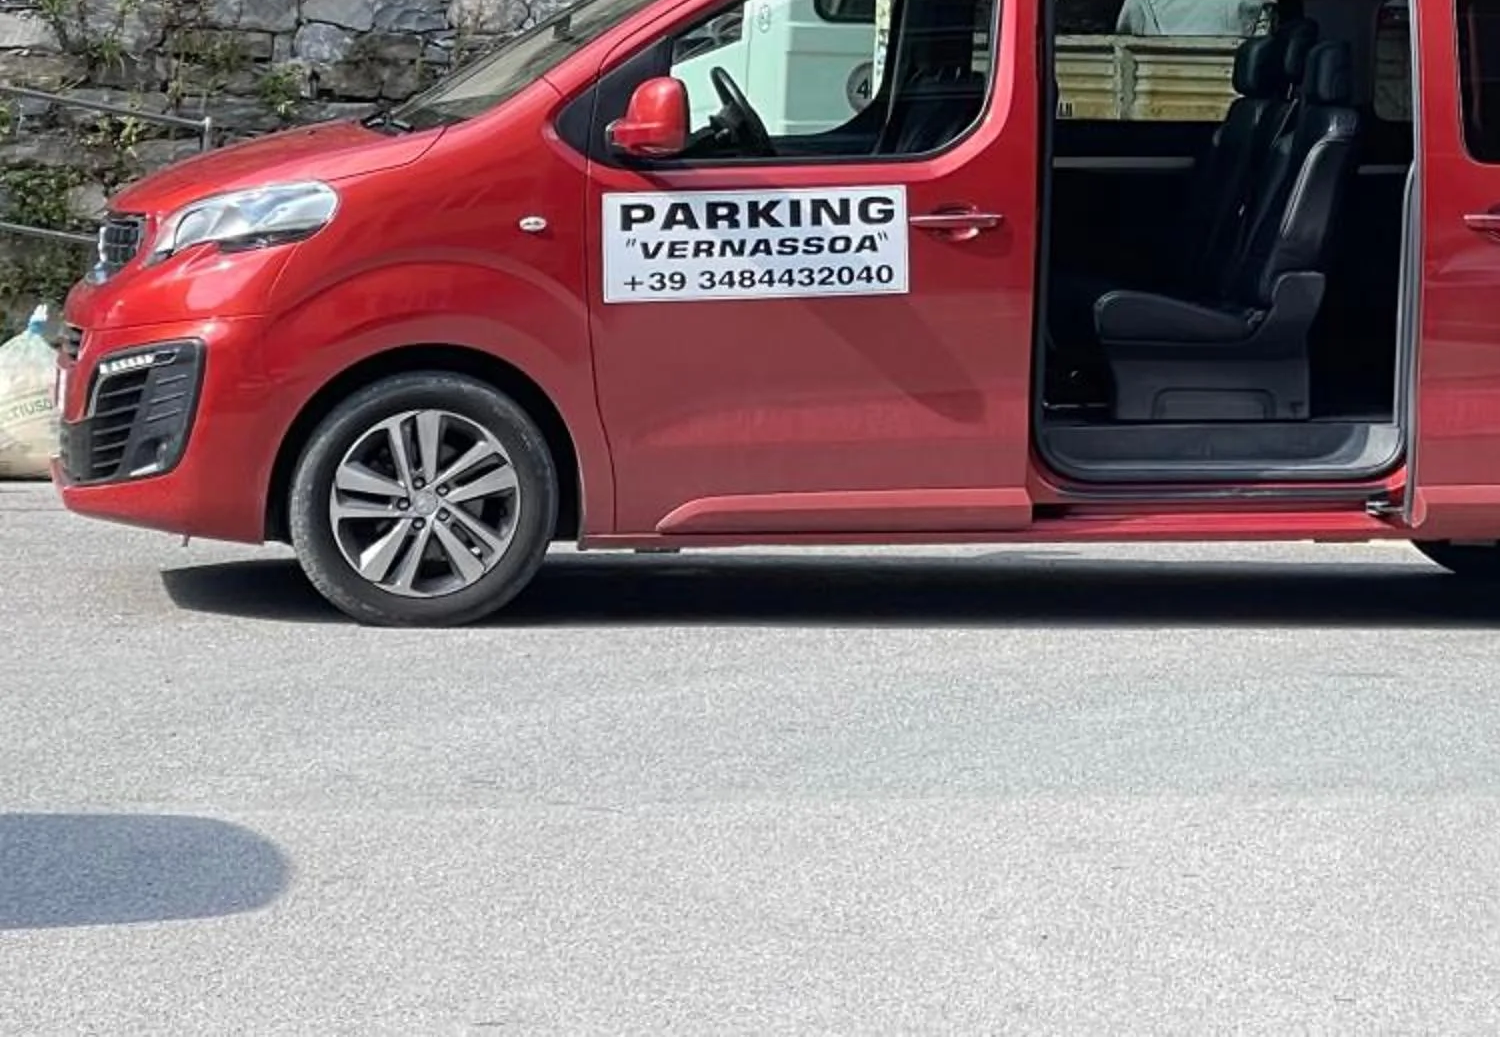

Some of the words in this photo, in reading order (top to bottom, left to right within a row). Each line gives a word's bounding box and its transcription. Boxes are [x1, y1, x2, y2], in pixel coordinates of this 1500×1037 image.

[619, 197, 896, 232] PARKING
[625, 231, 889, 260] "VERNASSOA"
[623, 272, 688, 293] +39
[699, 263, 894, 290] 3484432040
